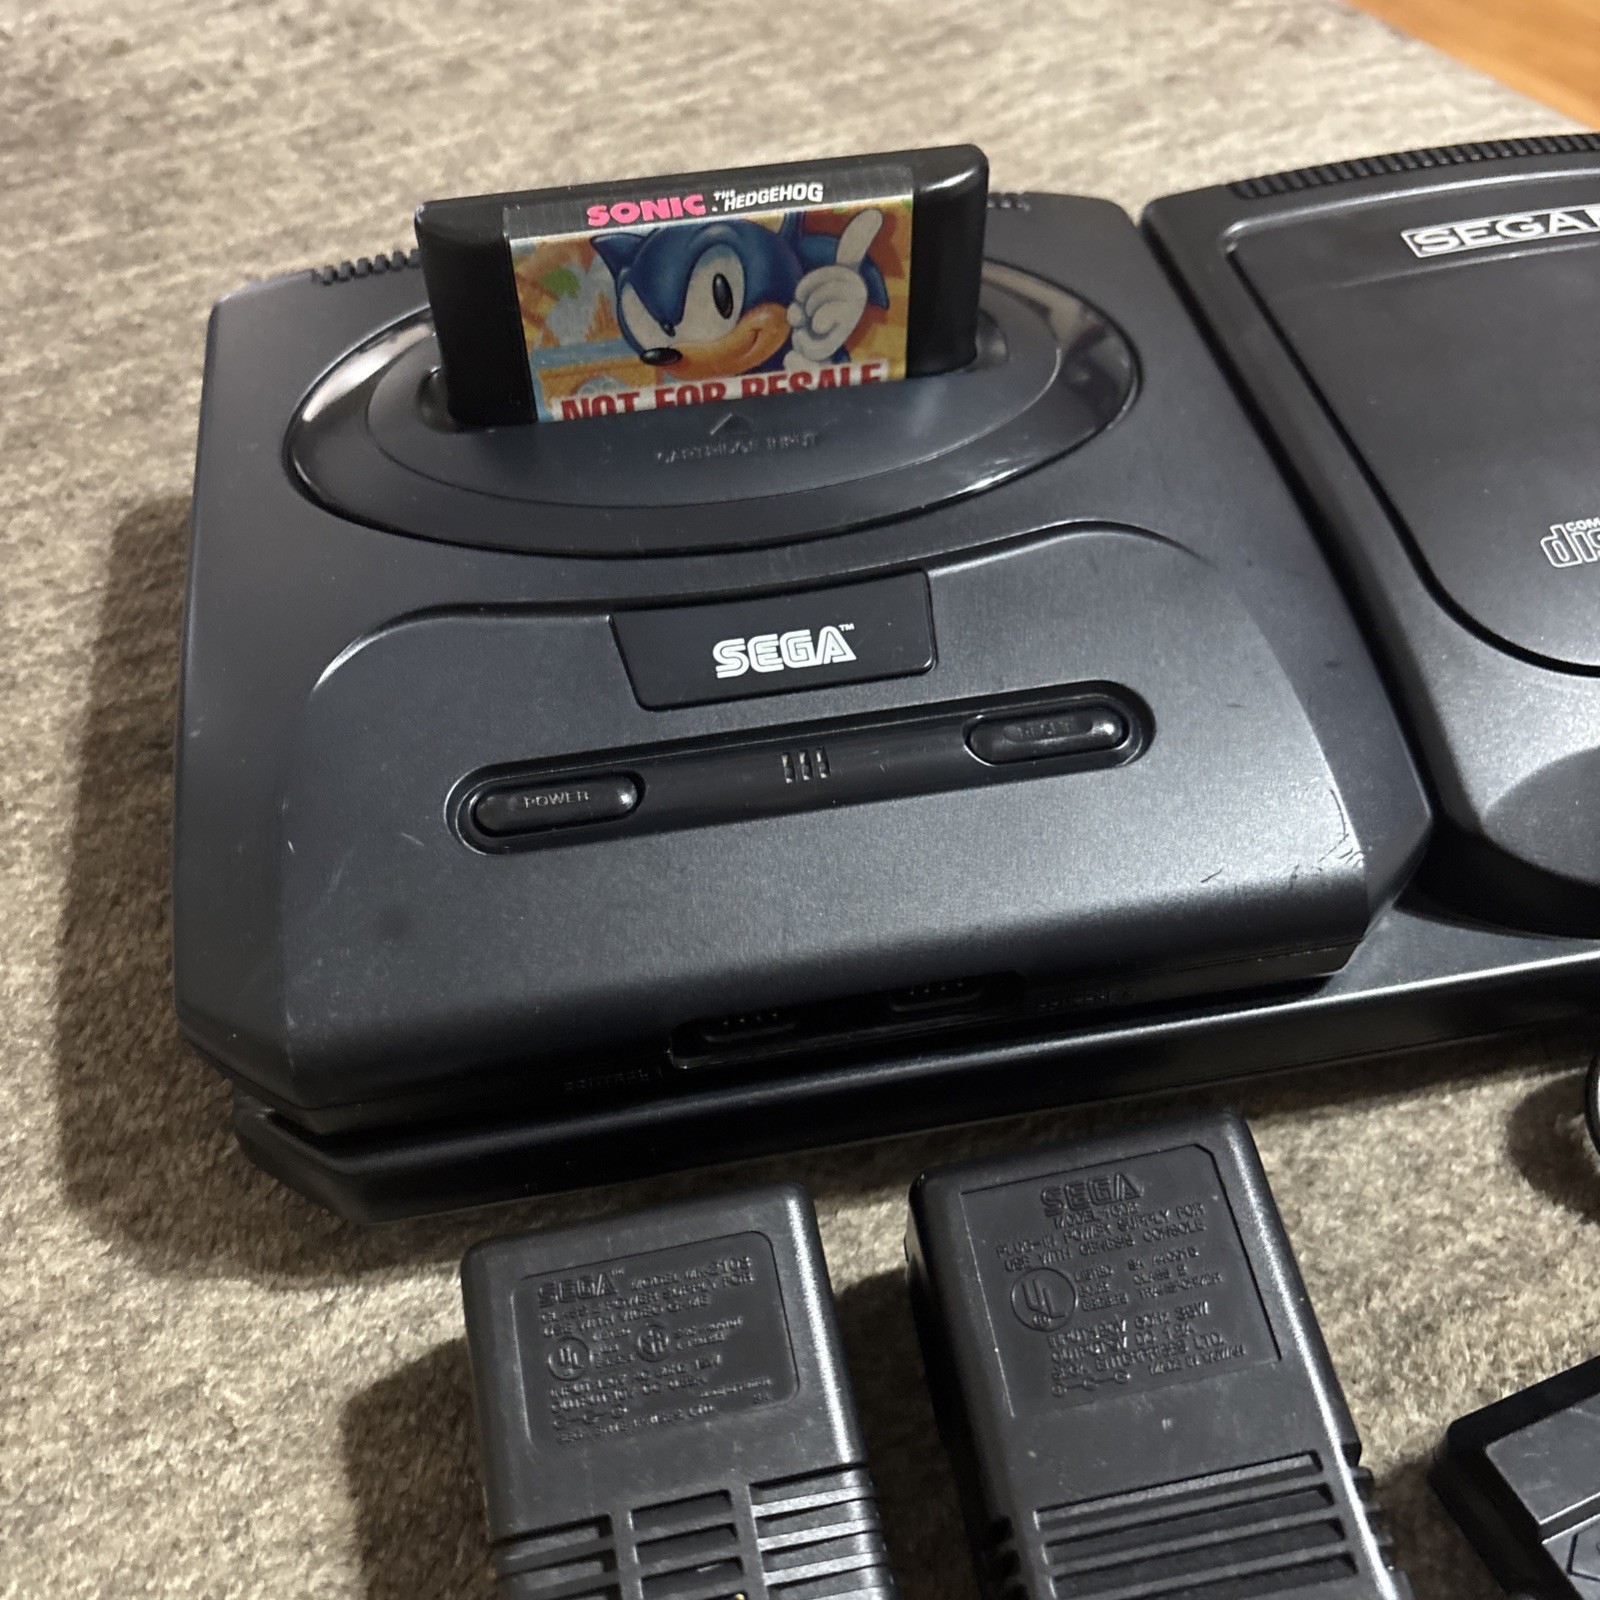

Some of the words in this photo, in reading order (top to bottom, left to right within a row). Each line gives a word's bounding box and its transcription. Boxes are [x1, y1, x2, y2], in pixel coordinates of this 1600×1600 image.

[587, 193, 707, 227] SONIC
[724, 181, 824, 212] HEDGEHOG
[1413, 212, 1590, 253] SEGA
[560, 392, 640, 422] NOT
[655, 382, 727, 409] FOR
[712, 625, 858, 679] SEGA
[523, 790, 590, 809] POWER
[1041, 1171, 1142, 1218] SEGA
[538, 1272, 619, 1309] SEGA
